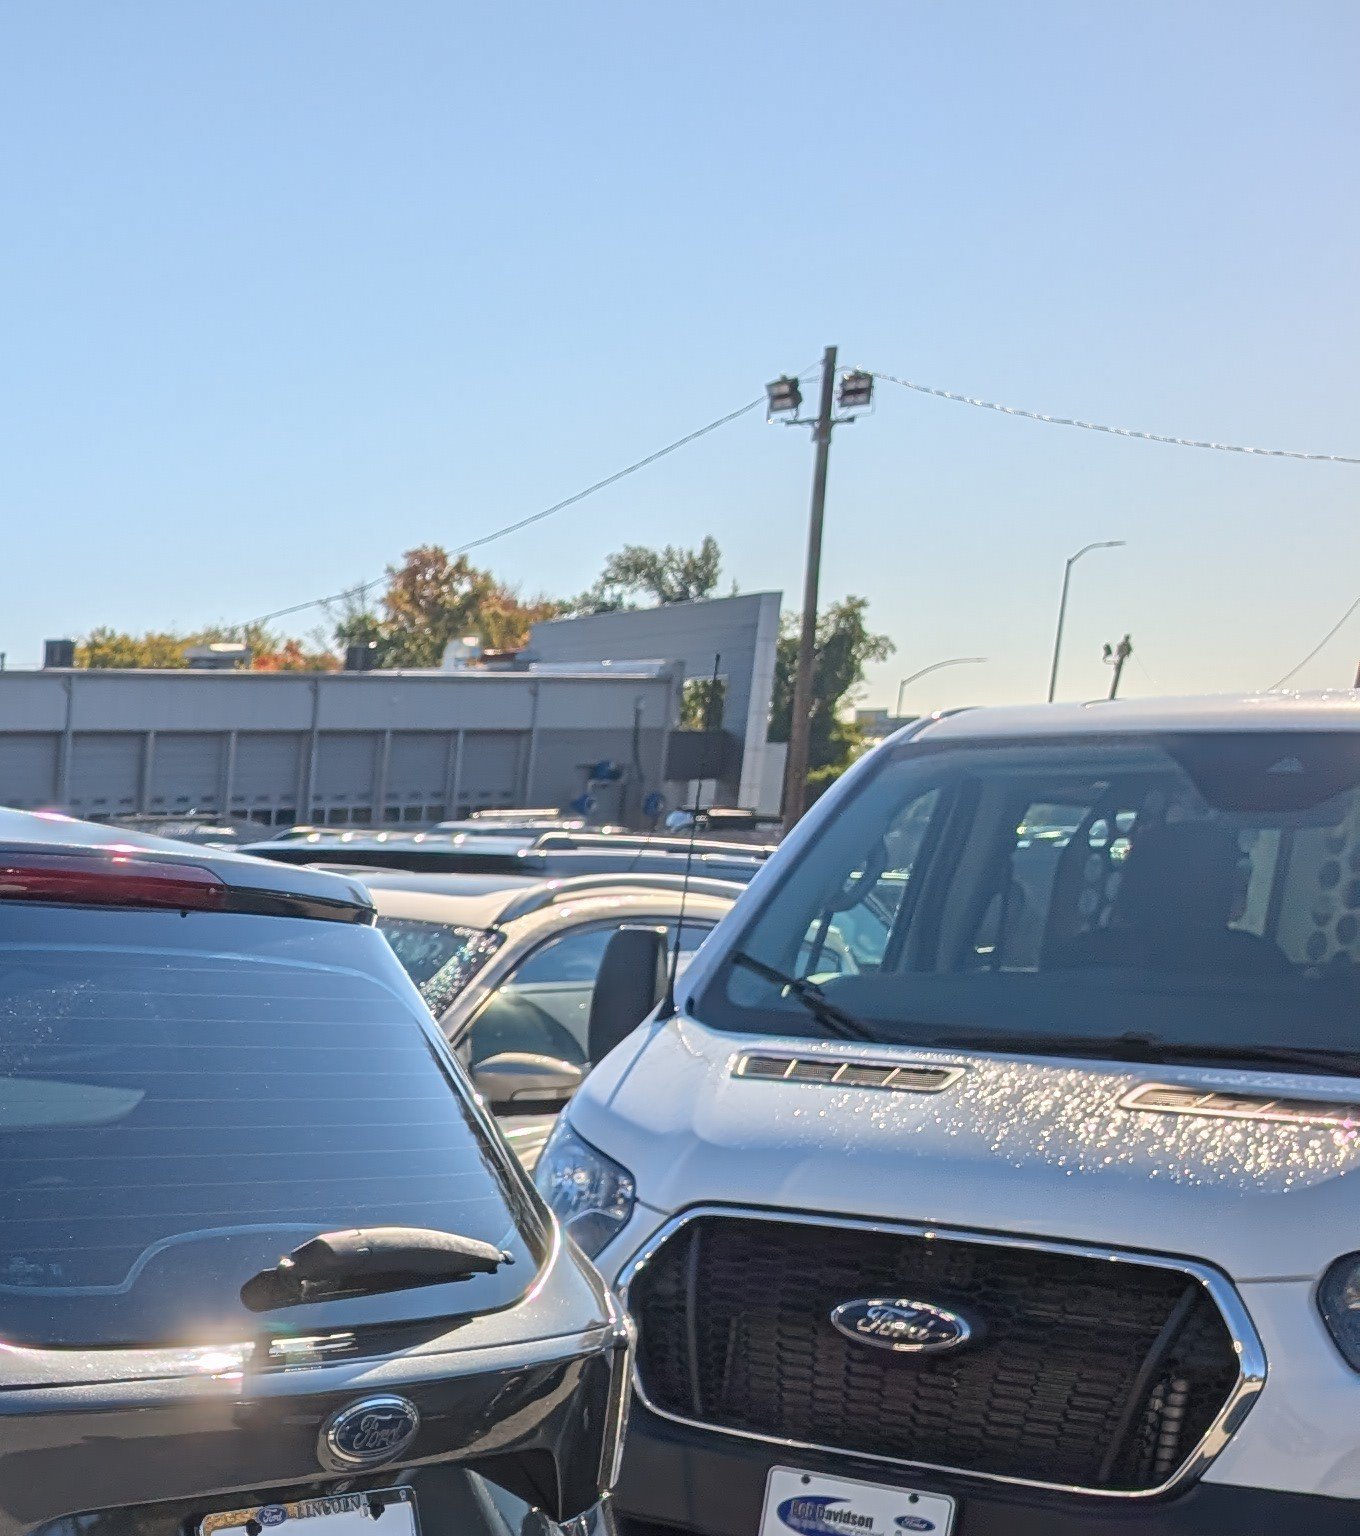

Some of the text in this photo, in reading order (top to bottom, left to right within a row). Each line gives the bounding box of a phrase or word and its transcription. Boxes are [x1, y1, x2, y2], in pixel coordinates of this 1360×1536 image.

[857, 1305, 938, 1341] Ford
[353, 1413, 404, 1450] Ford
[262, 1493, 360, 1523] Ford LINCOLN
[817, 1504, 874, 1530] Davidson
